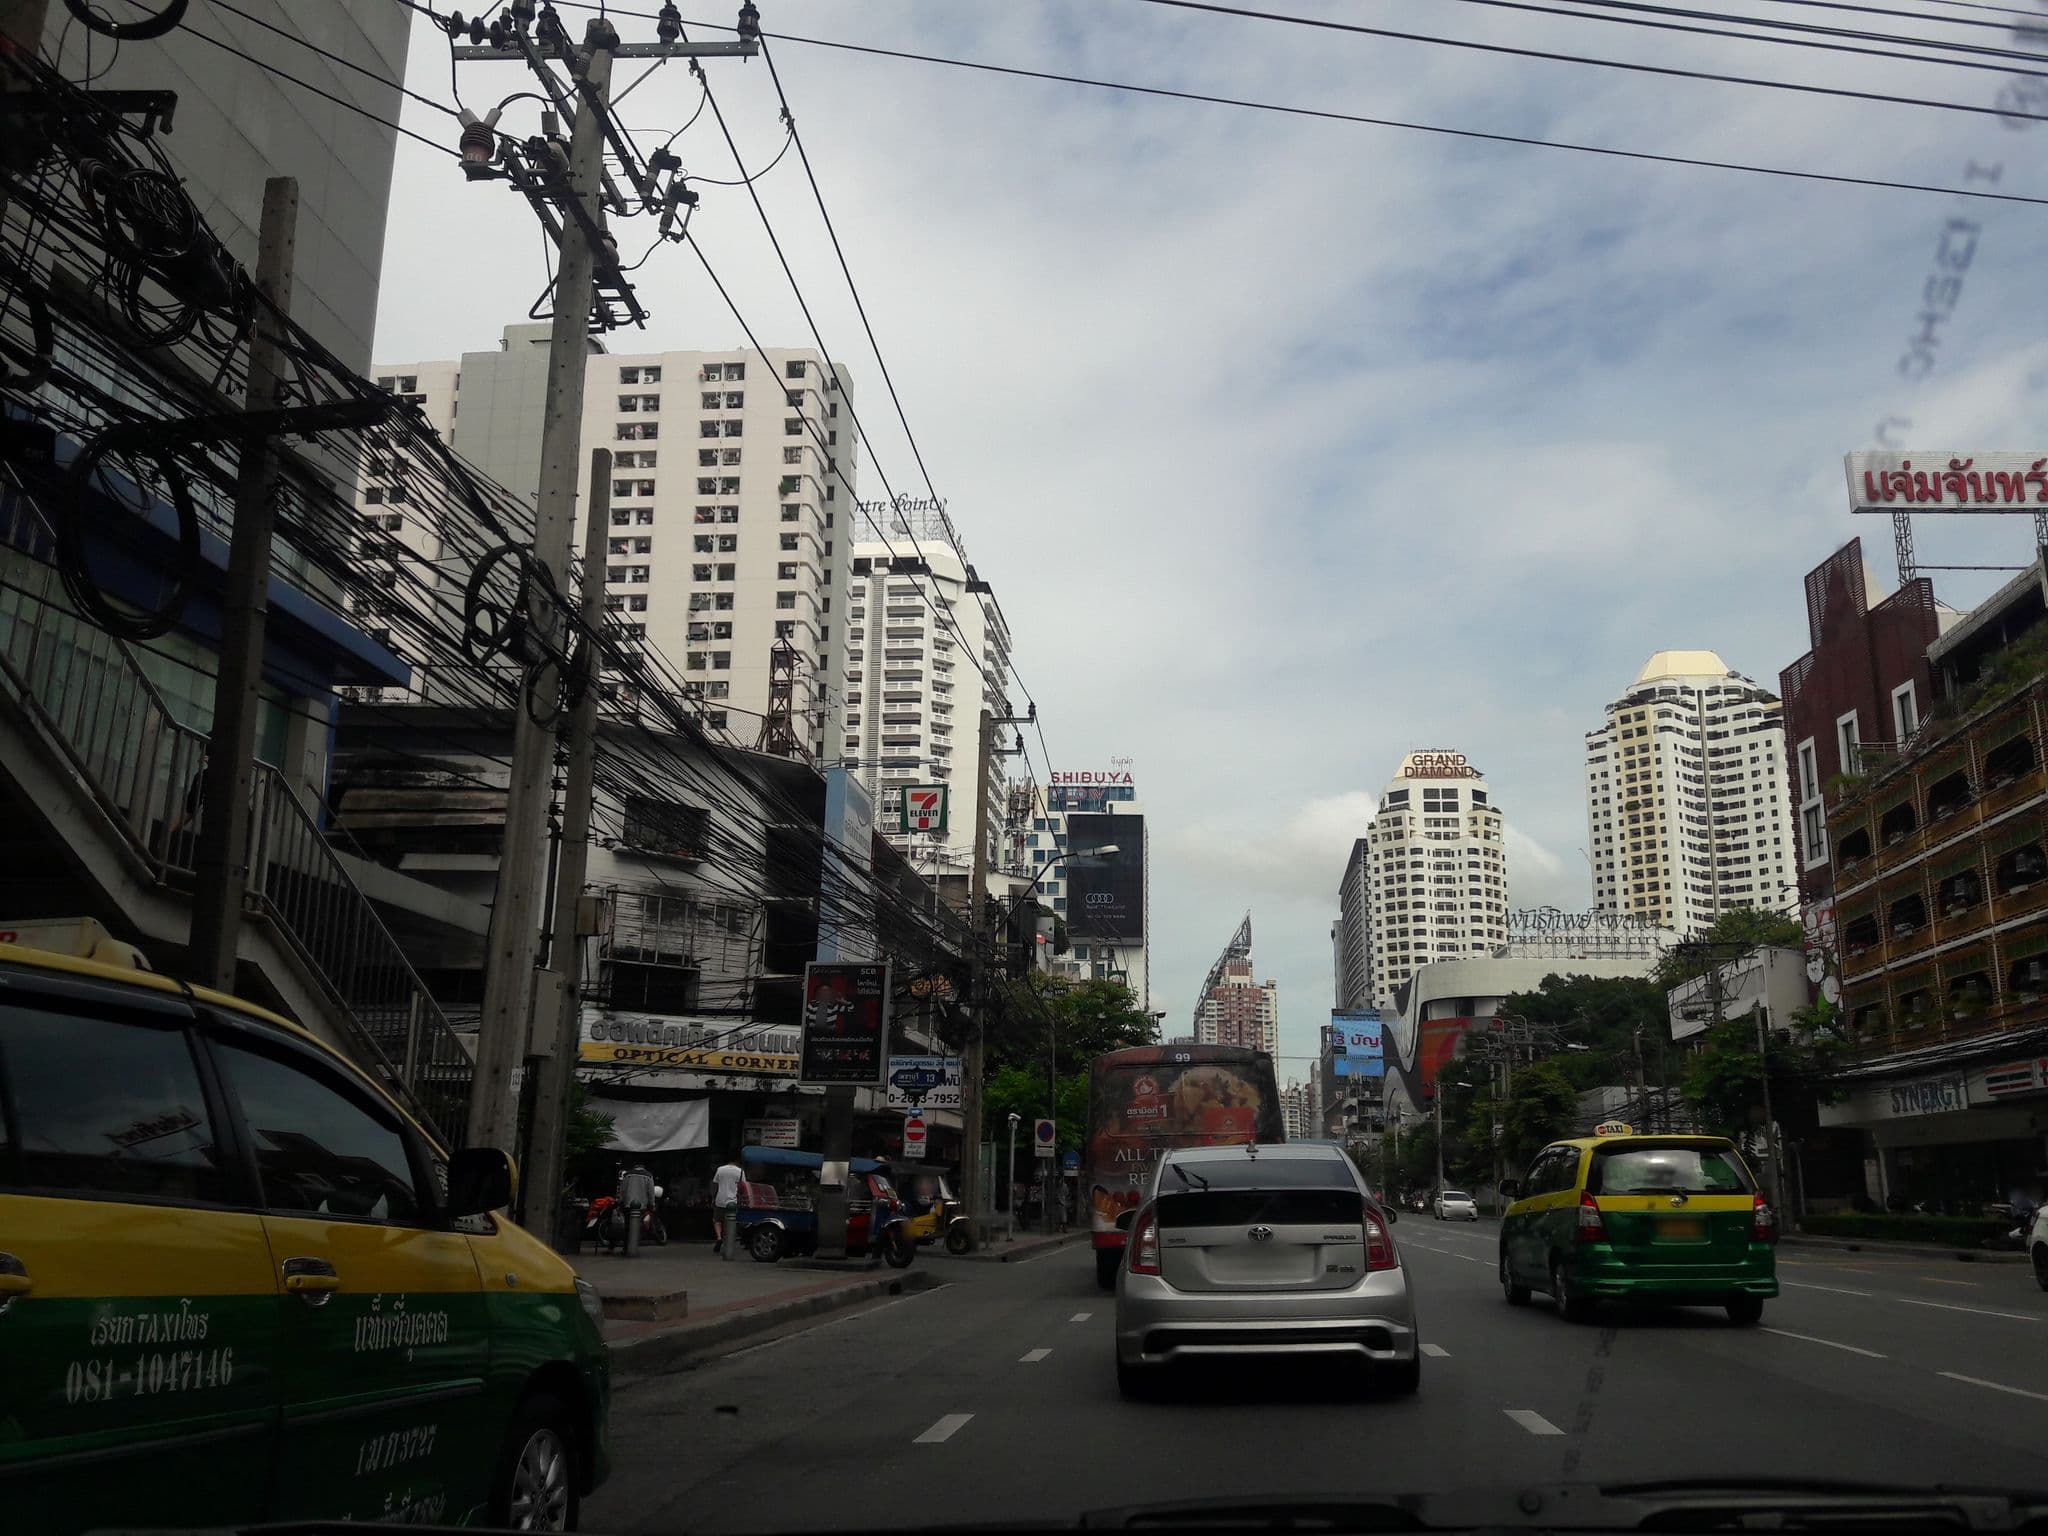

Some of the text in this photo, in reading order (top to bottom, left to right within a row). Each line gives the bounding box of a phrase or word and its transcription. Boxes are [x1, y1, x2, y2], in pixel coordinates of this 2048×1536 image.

[1866, 459, 2048, 503] แจ่มจันทร์
[1412, 754, 1467, 766] GRAND
[1051, 772, 1134, 784] SHIBUYA
[1404, 766, 1475, 778] DIAMOND
[911, 791, 938, 828] 7
[1509, 936, 1662, 946] THE COMPUTER CITY
[613, 1048, 800, 1070] OPTICAL CORNER
[1175, 1053, 1191, 1062] 99
[926, 1073, 936, 1083] 13
[1606, 1125, 1624, 1134] TAXI
[1114, 1148, 1145, 1163] ALL
[64, 1346, 234, 1406] 081-1047146
